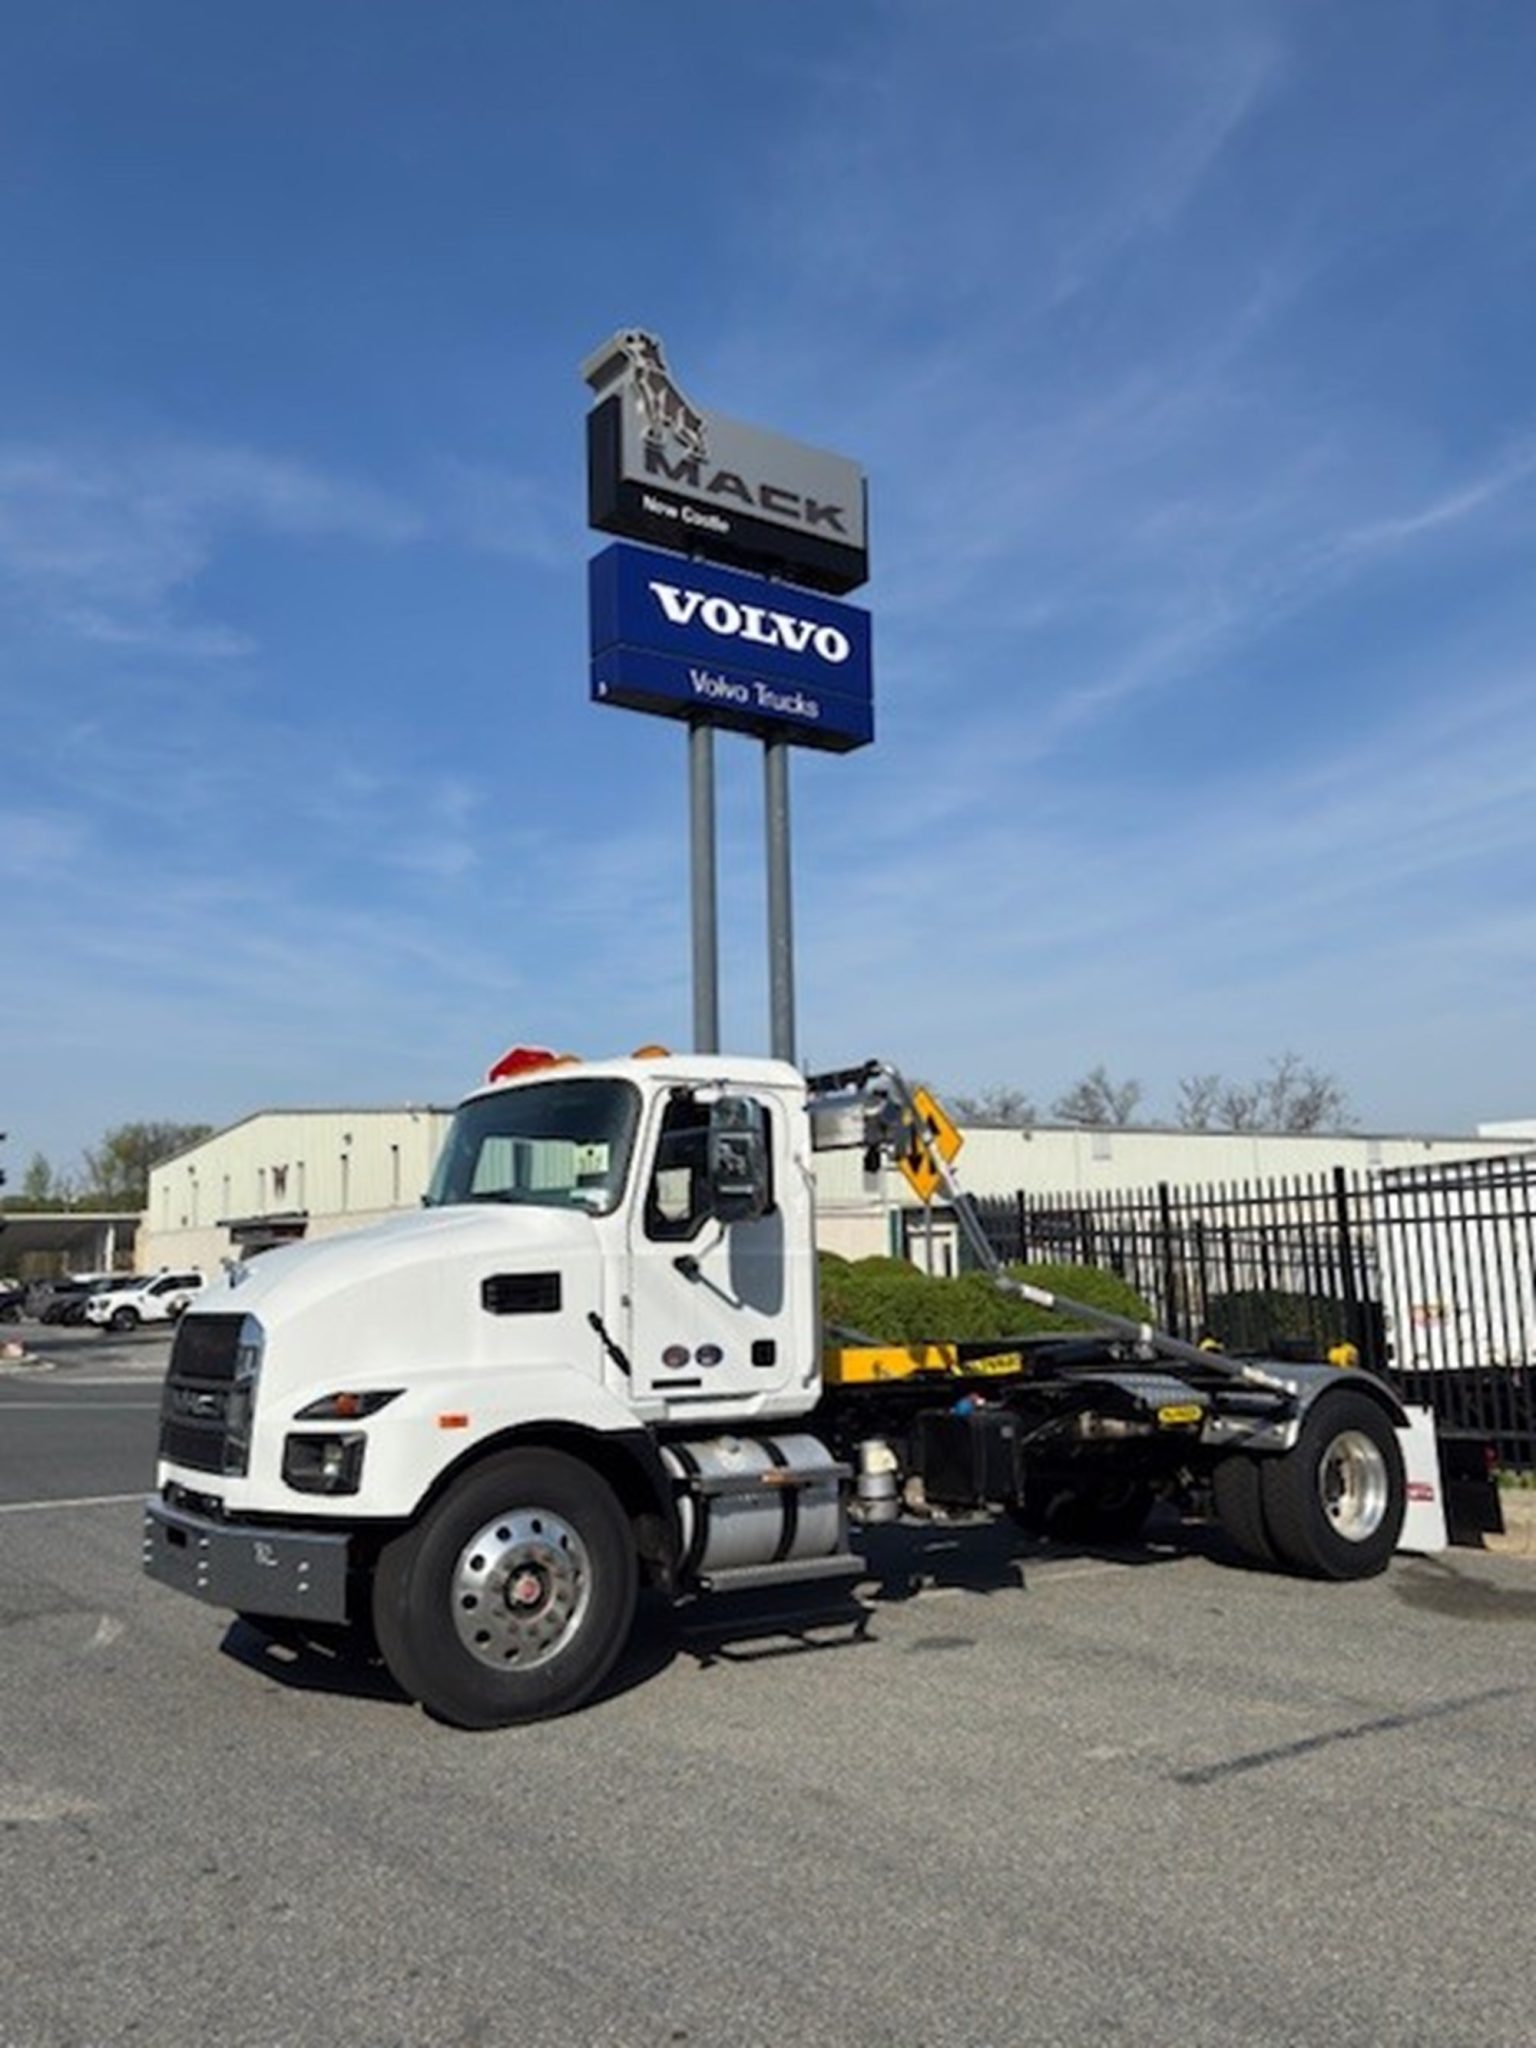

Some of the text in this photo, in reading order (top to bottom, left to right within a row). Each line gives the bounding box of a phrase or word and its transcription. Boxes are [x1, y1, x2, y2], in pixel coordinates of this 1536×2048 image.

[642, 494, 731, 533] New Castle
[645, 446, 848, 534] MACK
[649, 582, 850, 662] VOLVO
[689, 669, 820, 718] Volvo Trucks
